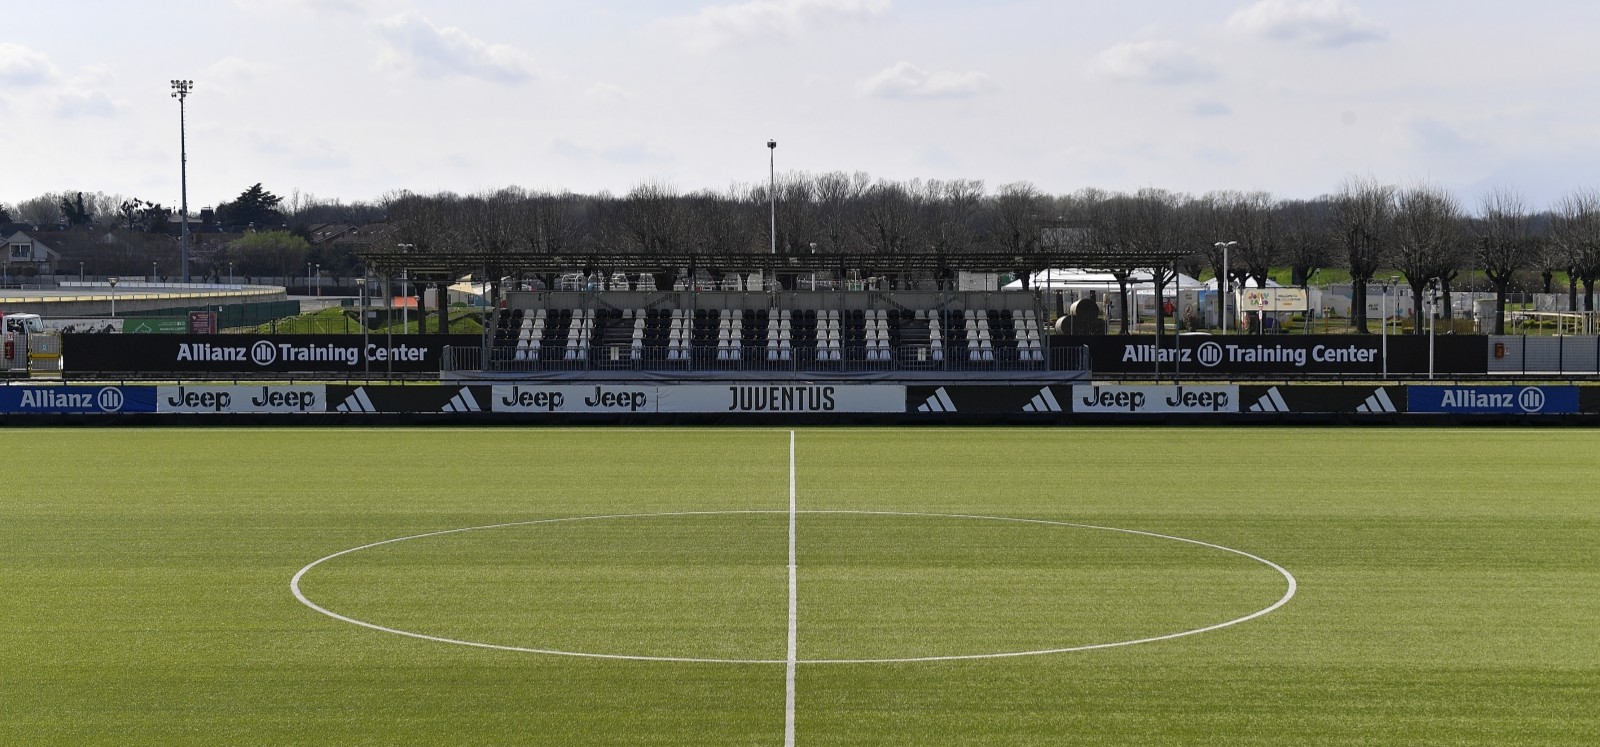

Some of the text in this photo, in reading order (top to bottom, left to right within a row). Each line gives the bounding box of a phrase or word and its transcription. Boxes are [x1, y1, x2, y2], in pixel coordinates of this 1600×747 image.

[177, 343, 428, 366] Allianz Training Center
[1122, 344, 1378, 367] Allianz Training Center
[20, 389, 93, 408] Allianz
[168, 386, 316, 411] Jeep Jeep
[502, 386, 647, 411] Jeep Jeep
[729, 386, 835, 411] JUVENTUS
[1083, 386, 1229, 411] Jeep Jeep
[1441, 389, 1514, 408] Allianz
